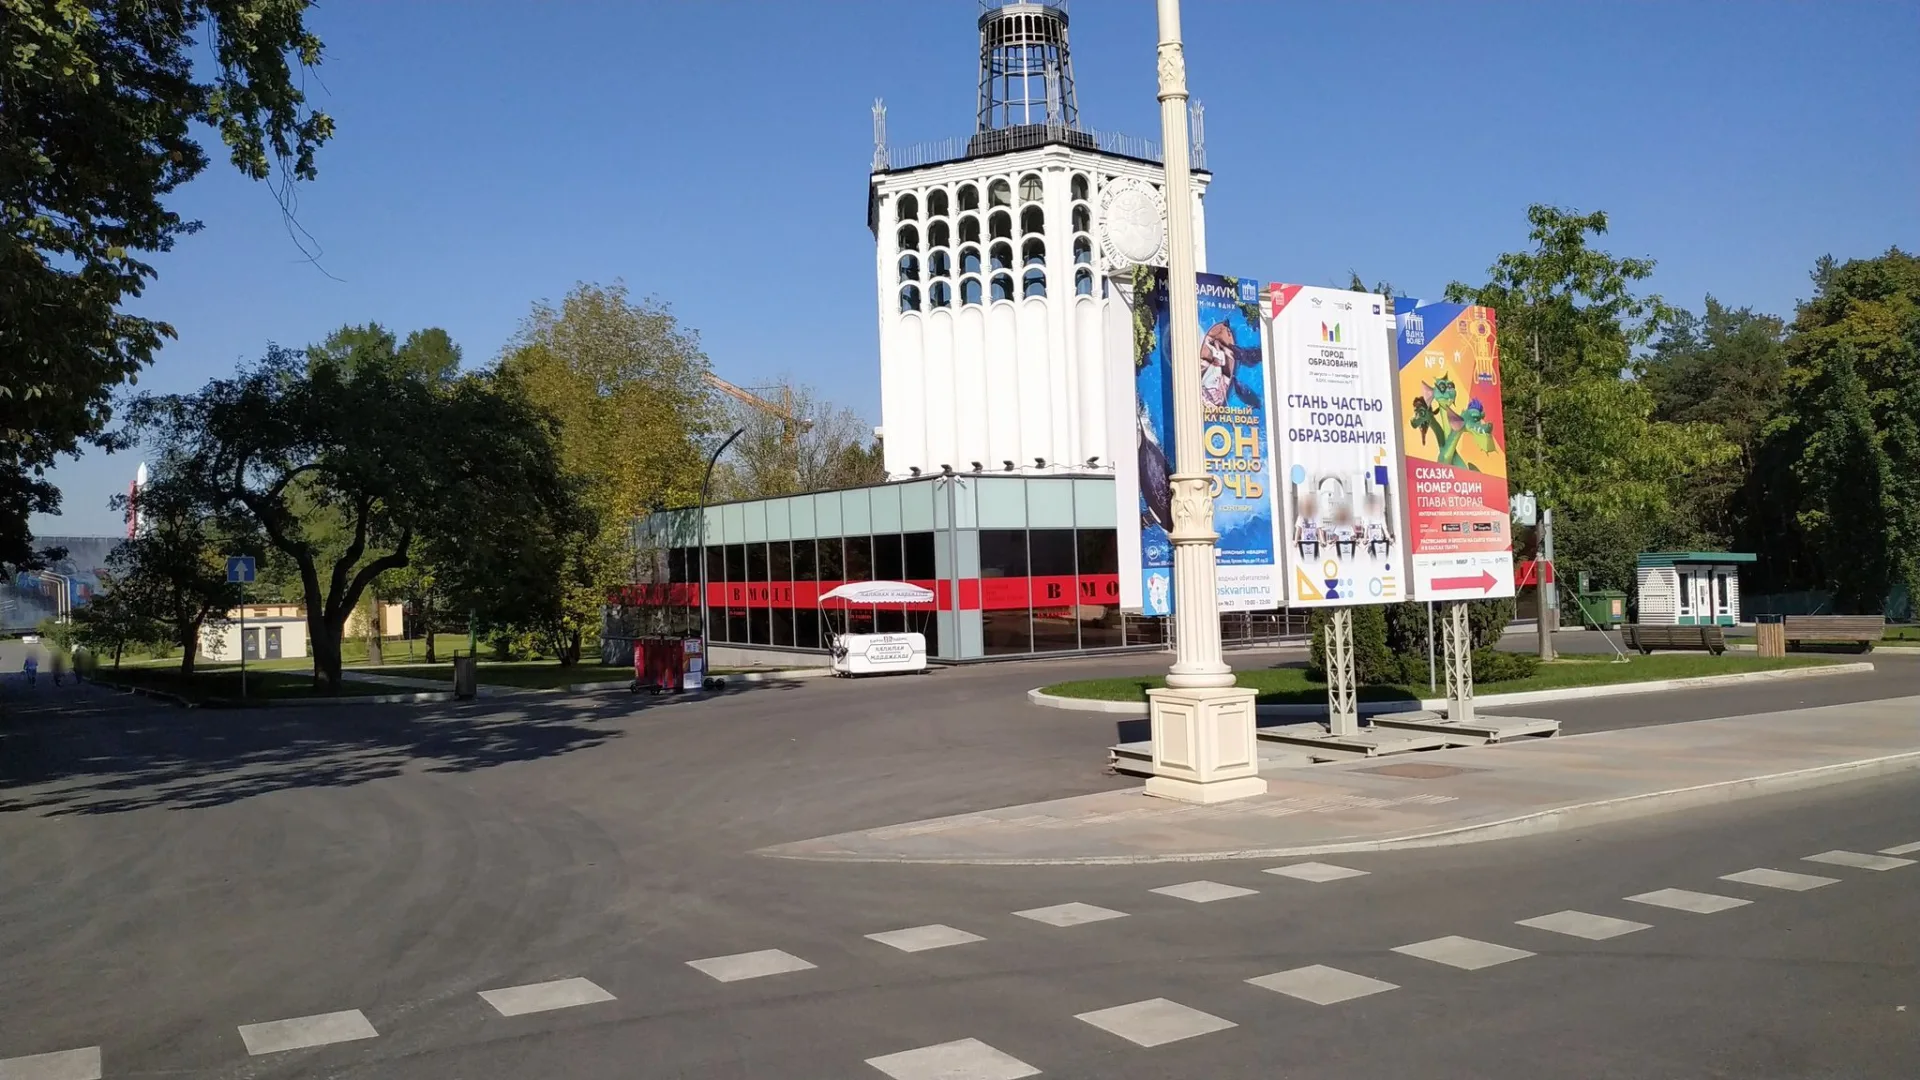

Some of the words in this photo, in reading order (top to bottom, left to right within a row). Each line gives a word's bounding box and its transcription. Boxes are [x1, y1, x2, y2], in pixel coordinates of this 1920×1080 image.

[1406, 330, 1424, 338] ВДНХ
[1320, 350, 1344, 359] ГОРОД
[1308, 357, 1358, 368] ОБРАЗОВАНИЯ
[1288, 394, 1328, 409] СТАНЬ
[1331, 397, 1383, 412] ЧАСТЬЮ
[1203, 405, 1253, 415] ДИОЗНЫЙ
[1234, 416, 1260, 424] ВОДЕ
[1311, 412, 1363, 427] ГОРОДА
[1204, 425, 1260, 459] ОН
[1289, 428, 1386, 445] ОБРАЗОВАНИЯ!
[1206, 458, 1262, 472] ЕТНЮЮ
[1416, 468, 1454, 479] СКАЗКА
[1416, 482, 1452, 493] НОМЕР
[1454, 482, 1482, 494] ОДИН
[1418, 496, 1446, 507] ГЛАВА
[1448, 496, 1483, 506] ВТОРАЯ
[1216, 584, 1270, 595] oskvarium.ru
